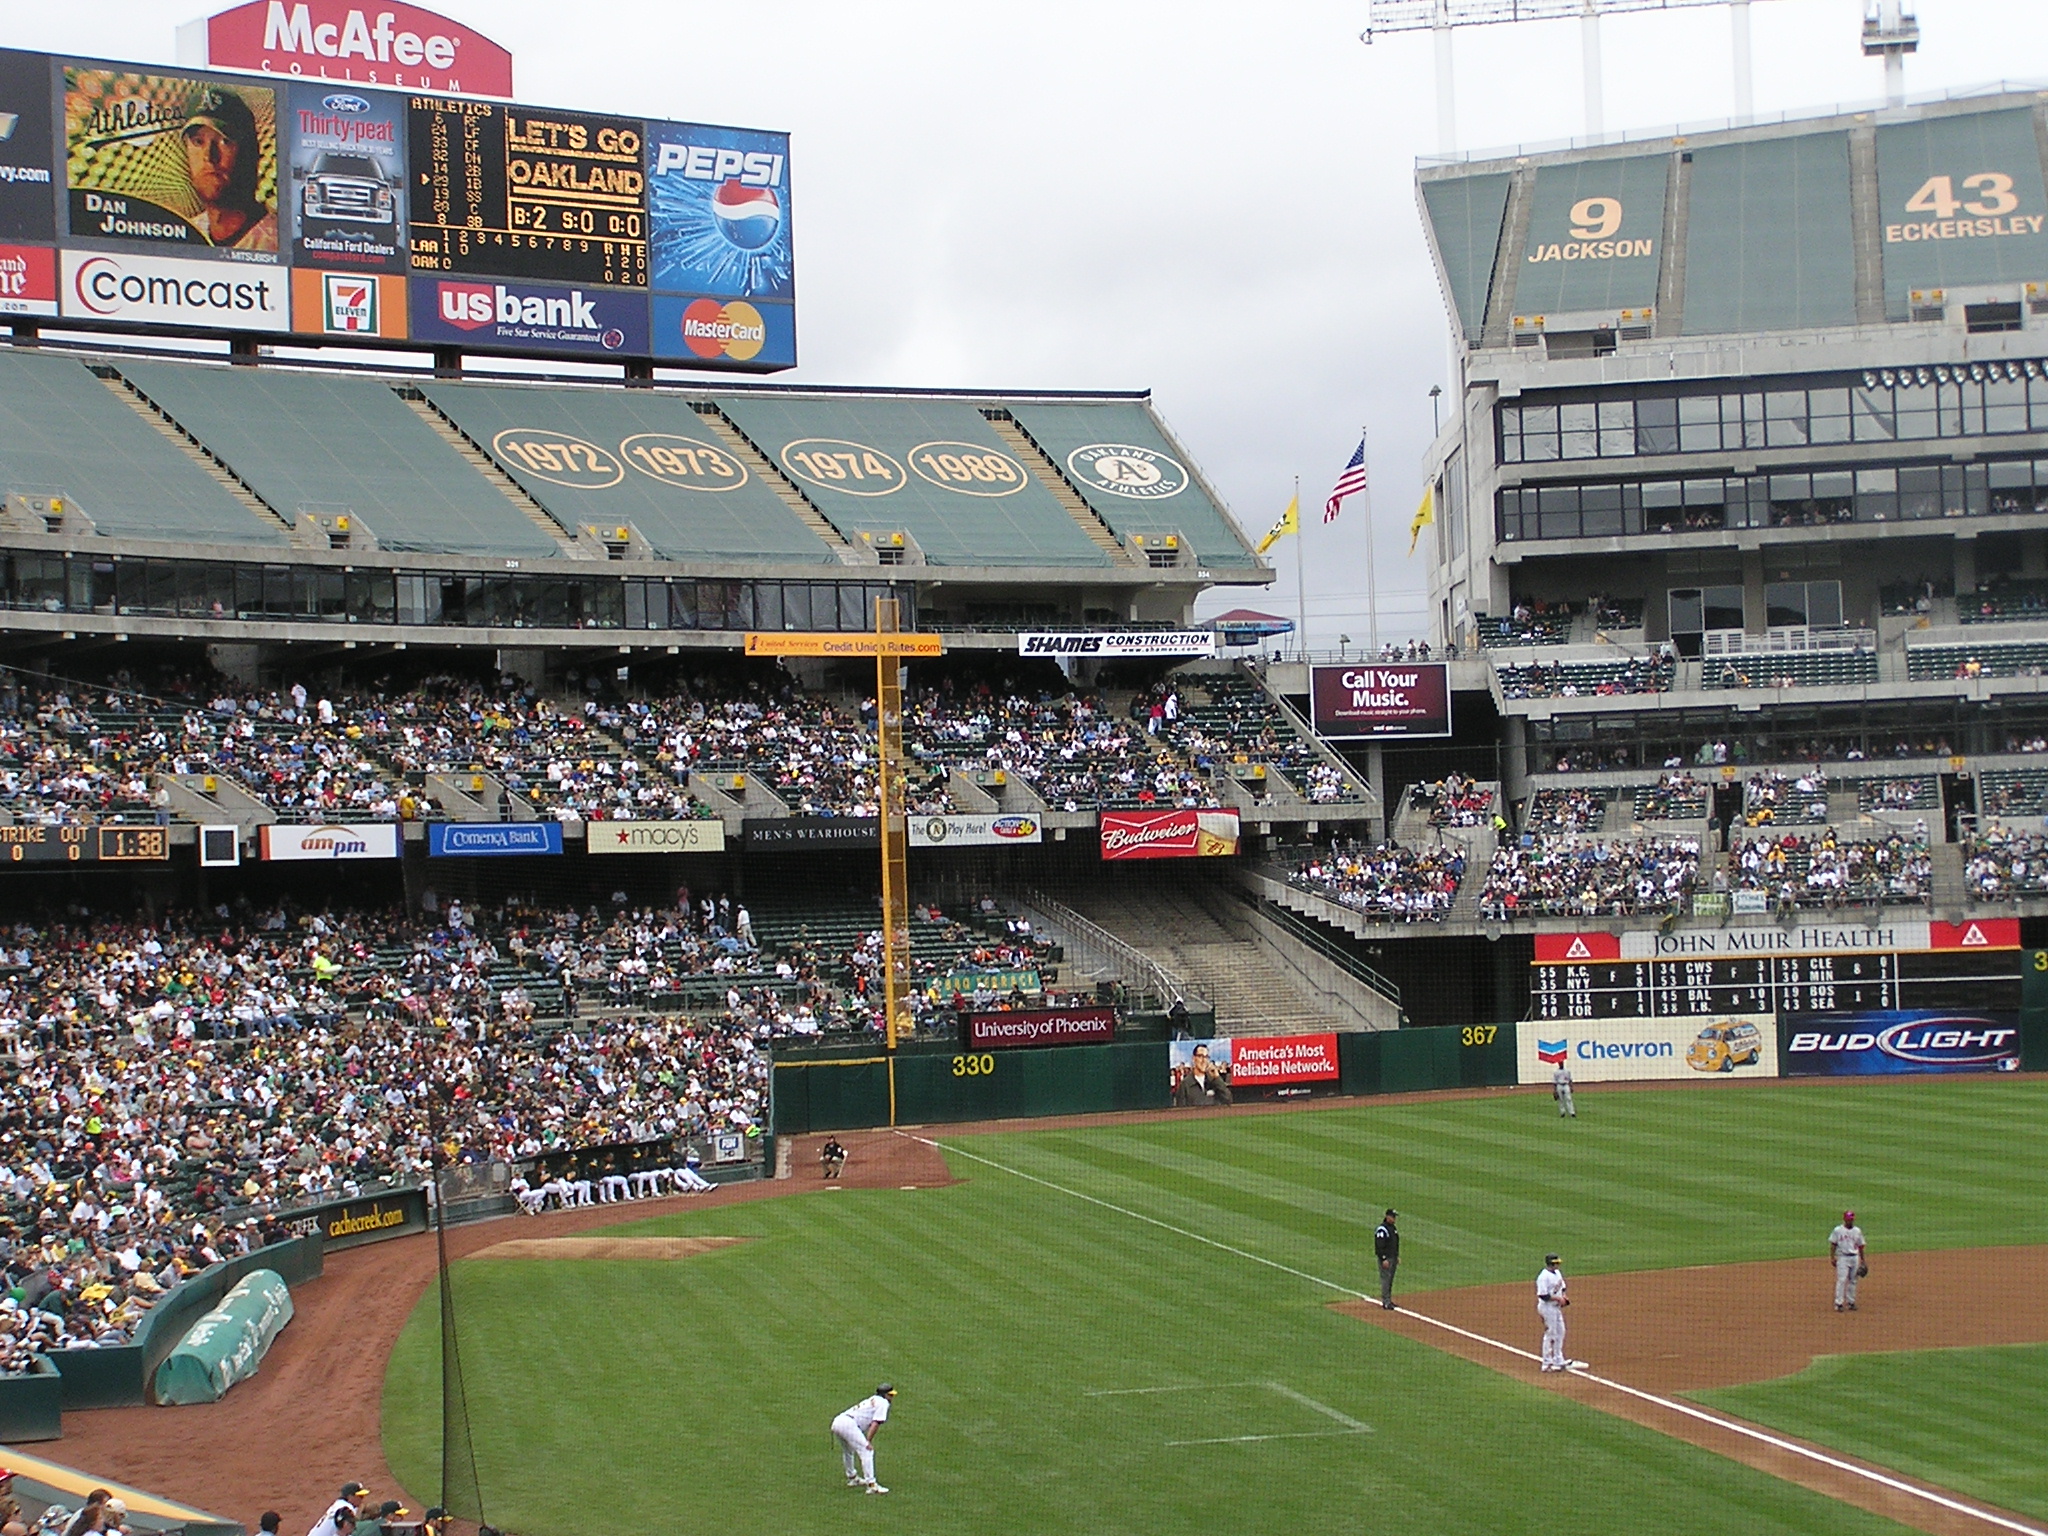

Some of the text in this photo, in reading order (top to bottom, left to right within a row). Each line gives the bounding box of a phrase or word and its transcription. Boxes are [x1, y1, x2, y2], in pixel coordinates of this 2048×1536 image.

[263, 0, 456, 69] McAfee
[261, 59, 461, 92] COLISEUM
[84, 99, 188, 137] Athletics
[297, 109, 395, 143] Thirty-peat
[508, 117, 640, 155] LET'S GO
[432, 162, 449, 175] 14
[656, 142, 784, 187] PEPSI
[508, 159, 645, 195] OAKLAND
[86, 193, 127, 214] DAN
[1905, 172, 2020, 218] 43
[100, 215, 187, 239] JOHNSON
[514, 205, 547, 230] B:2
[562, 210, 594, 234] S:0
[1568, 196, 1624, 241] 9
[1885, 215, 2046, 244] ECKERSLEY
[303, 237, 396, 256] California Ford Dealers
[442, 229, 646, 258] 1 2 3 4 5 6 7 8 9 R H E
[1527, 238, 1654, 264] JACKSON
[442, 242, 450, 254] 1
[459, 243, 469, 256] 0
[604, 255, 612, 267] 1
[620, 256, 631, 269] 2
[636, 257, 646, 270] 0
[442, 256, 452, 270] 0
[604, 270, 614, 283] 0
[621, 272, 631, 284] 2
[636, 275, 646, 285] 0
[496, 326, 600, 343] Five Star Service Guaranteed
[684, 319, 764, 341] MasterCard
[505, 441, 613, 472] 1972
[632, 446, 735, 477] 1973
[793, 452, 894, 480] 1974
[1079, 448, 1157, 462] OAKLAND
[919, 453, 1018, 483] 1989
[1095, 479, 1178, 496] ATHLETICS
[823, 641, 853, 652] Credit
[1023, 634, 1210, 653] SHAMES CONSTRUCTION
[1341, 670, 1419, 689] Call Your
[1352, 688, 1410, 708] Music.
[0, 826, 90, 843] TRIKE OUT
[508, 830, 540, 844] Bank
[631, 824, 699, 850] macy's
[752, 826, 877, 841] MEN'S WEARHOUSE
[912, 823, 926, 836] The
[948, 822, 963, 837] Play
[965, 822, 987, 835] Here!
[1017, 819, 1034, 836] 36
[1100, 822, 1196, 850] Budweiser
[12, 832, 163, 861] 0 0 1:38
[1653, 928, 1895, 958] JOHN MUIR HEALTH
[1540, 955, 1887, 979] 55 K.C. 5 34 CWS 3 55 CLE 0
[1540, 968, 1887, 991] 35 NYY 53 DET 1 30 MIN 1
[1540, 995, 1889, 1017] 40 TOR 4 38 T.B. 3 43 SEA 0
[1541, 983, 1888, 1005] 55 TEX 1 45 BAL 10 19 BOS 1 2
[974, 1016, 1107, 1039] University of Phoenix
[1461, 1025, 1498, 1046] 367
[1238, 1044, 1325, 1061] America's Most
[1576, 1040, 1674, 1060] Chevron
[1788, 1029, 2017, 1052] BUD LIGHT
[952, 1053, 995, 1077] 330
[1233, 1058, 1335, 1077] Reliable Network.
[329, 1203, 404, 1237] cachecreek.com
